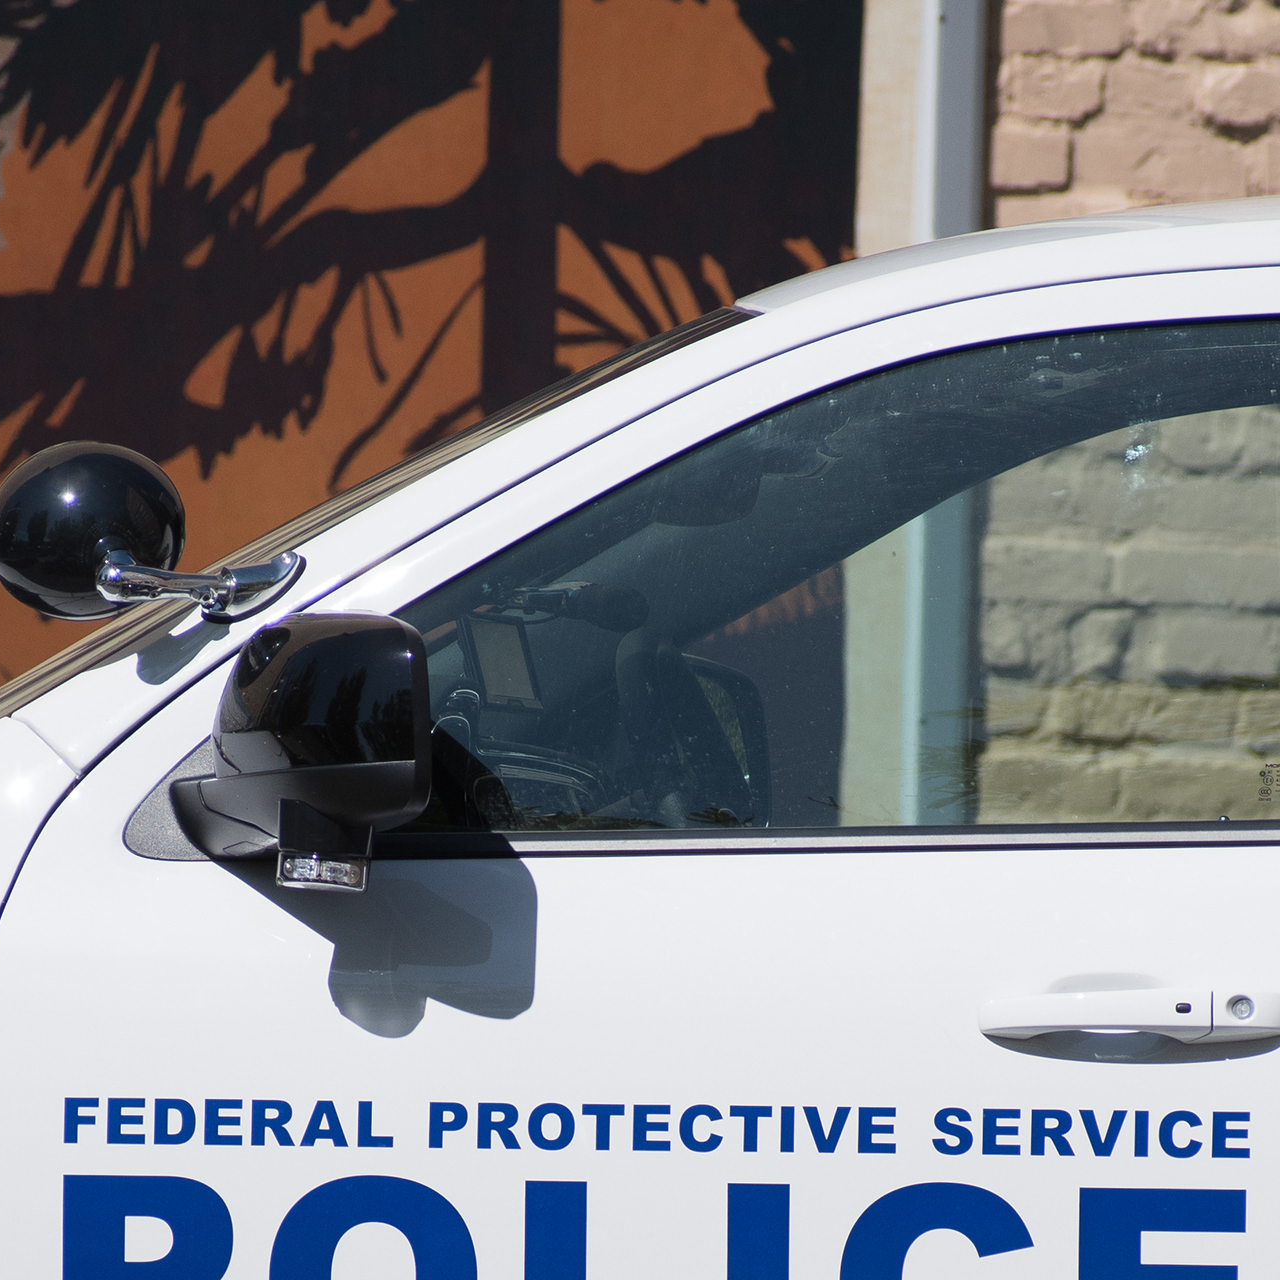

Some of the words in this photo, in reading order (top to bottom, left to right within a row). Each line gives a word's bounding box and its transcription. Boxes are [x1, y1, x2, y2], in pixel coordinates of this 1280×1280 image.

[63, 1097, 394, 1148] FEDERAL
[428, 1102, 897, 1155] PROTECTIVE
[932, 1107, 1251, 1159] SERVICE
